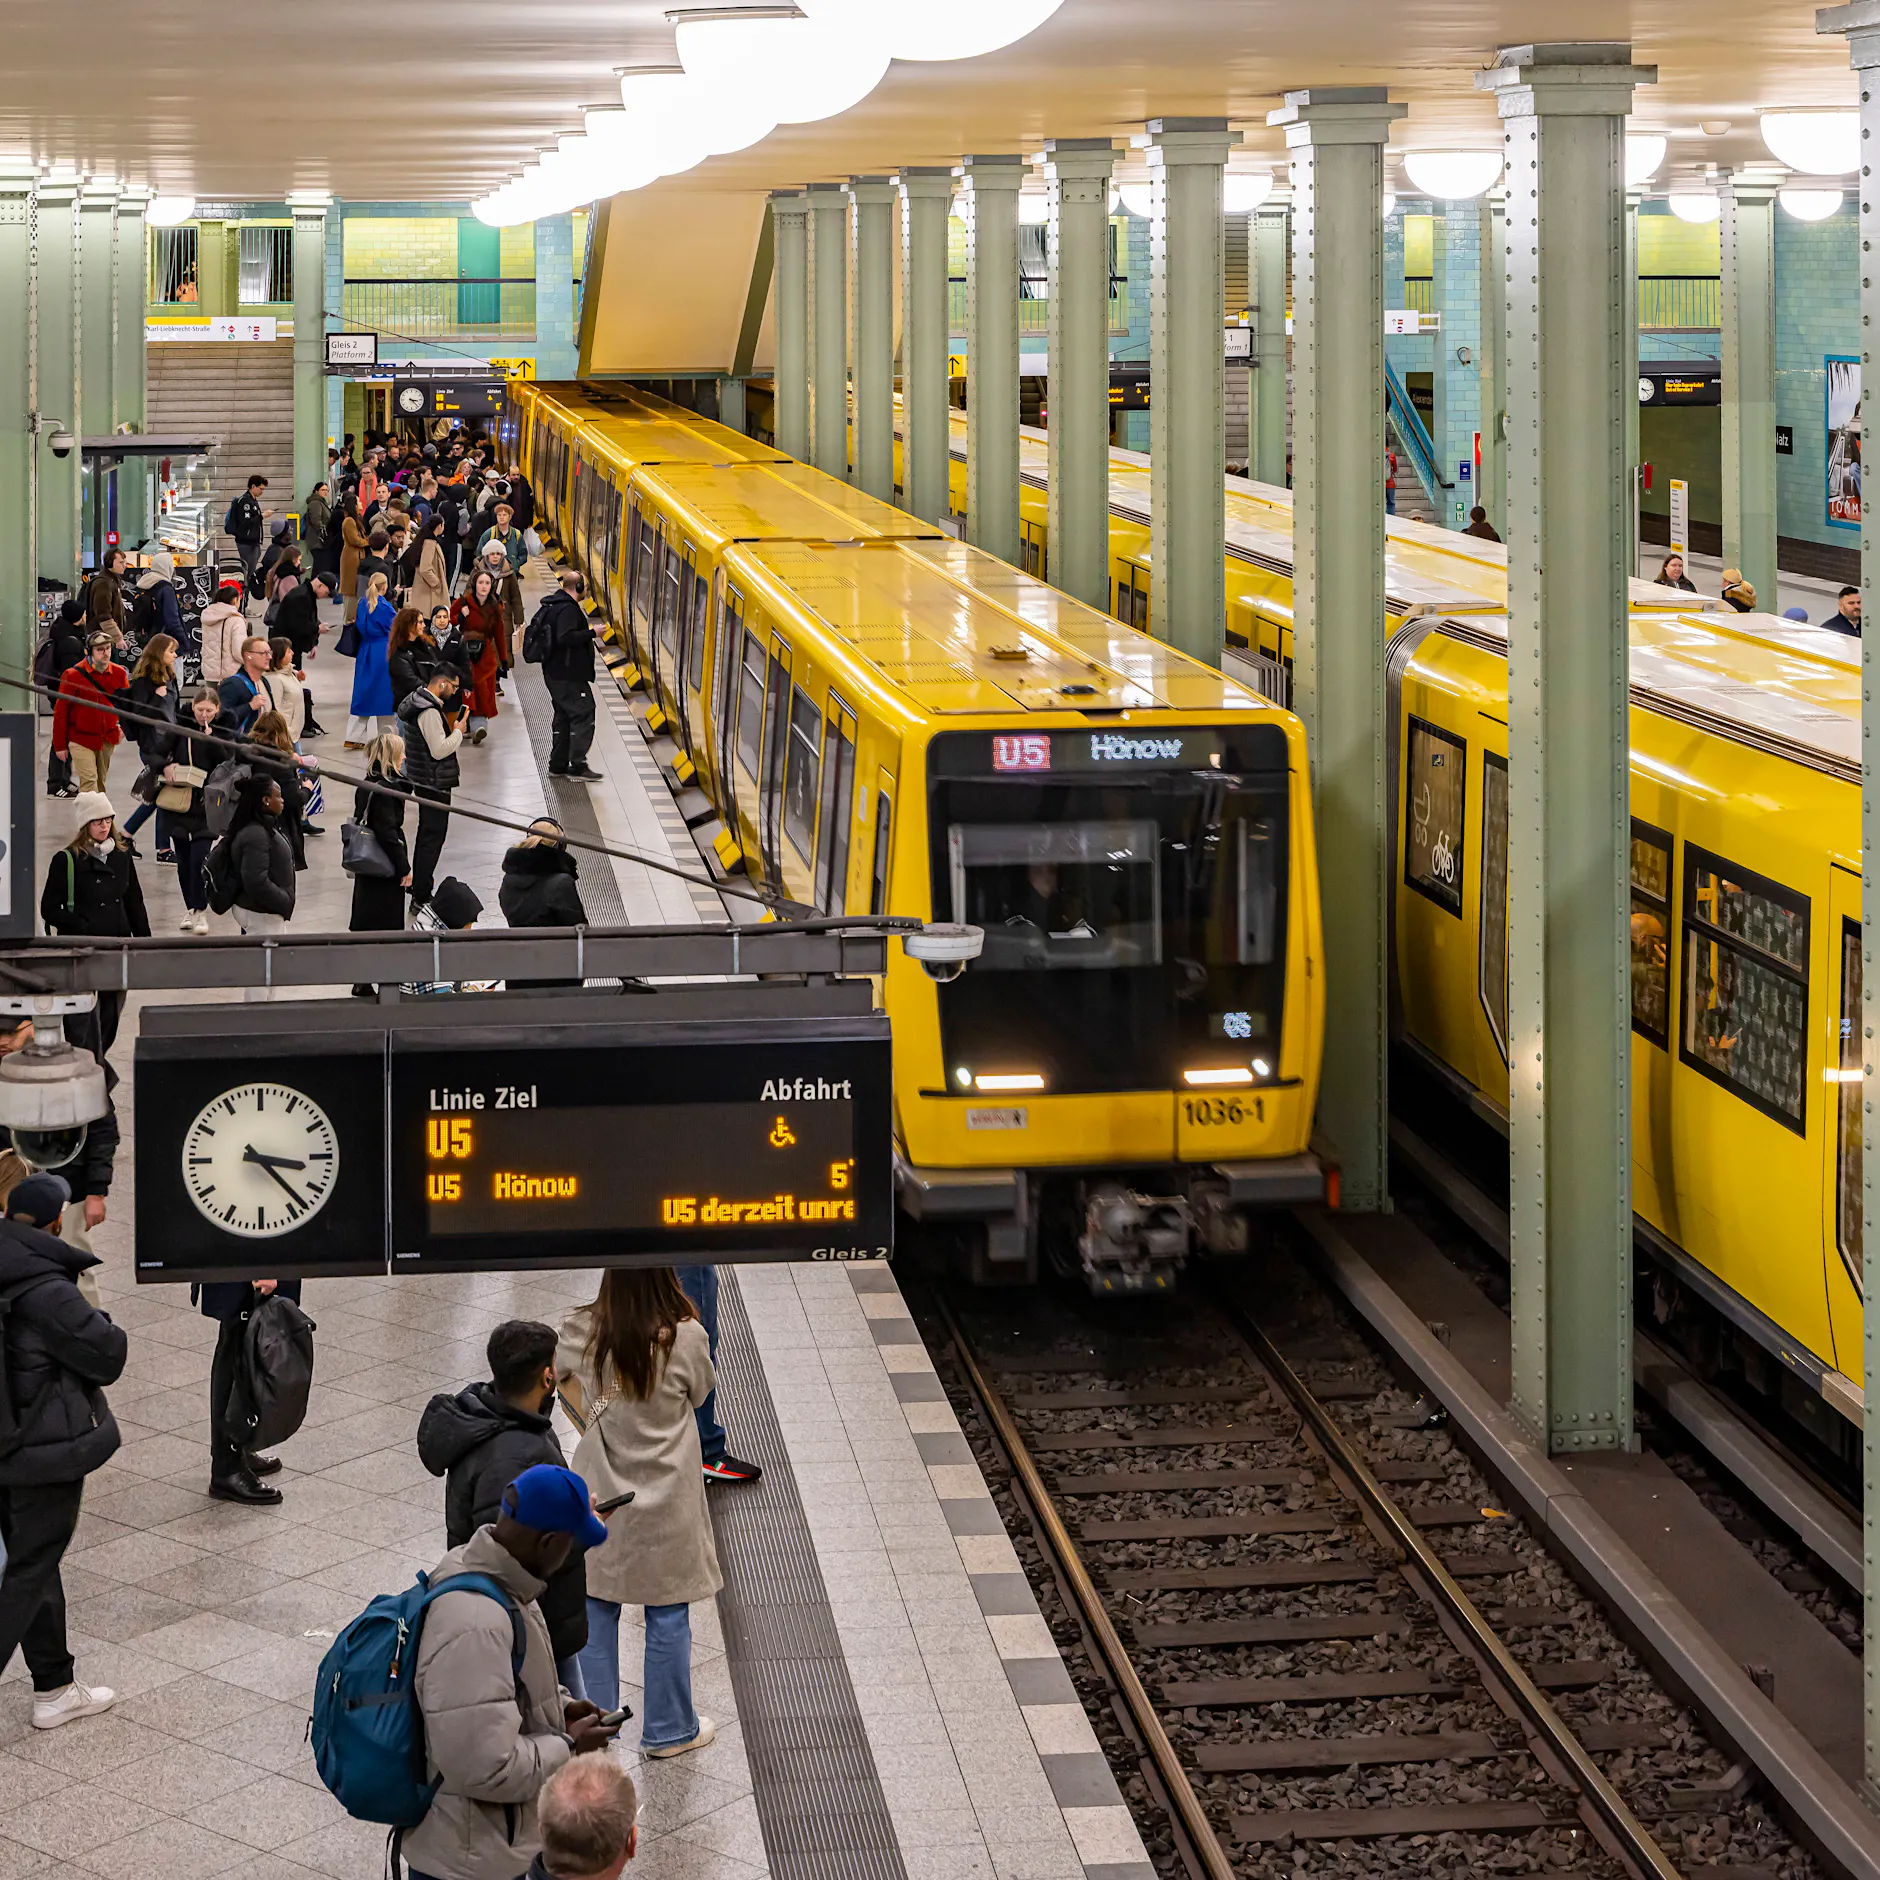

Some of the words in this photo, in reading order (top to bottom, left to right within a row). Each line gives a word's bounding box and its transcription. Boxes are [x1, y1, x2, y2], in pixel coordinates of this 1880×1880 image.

[331, 340, 351, 349] Gleis
[352, 340, 358, 349] 2
[331, 350, 366, 359] Platform
[367, 350, 373, 359] 2
[1225, 343, 1242, 351] form
[1776, 432, 1789, 446] latz
[1831, 500, 1861, 516] TOMM
[999, 737, 1046, 767] U5
[1090, 733, 1184, 761] Hönow
[430, 1087, 485, 1111] Linie
[494, 1084, 538, 1109] Ziel
[760, 1076, 852, 1101] Abfahrt
[1181, 1095, 1265, 1127] 1036-1
[428, 1118, 472, 1158] U5
[428, 1174, 462, 1200] U5
[494, 1172, 577, 1198] Hönow
[662, 1197, 697, 1224] U5
[700, 1195, 795, 1222] derzeit
[811, 1247, 868, 1261] Gleis
[875, 1247, 888, 1259] 2
